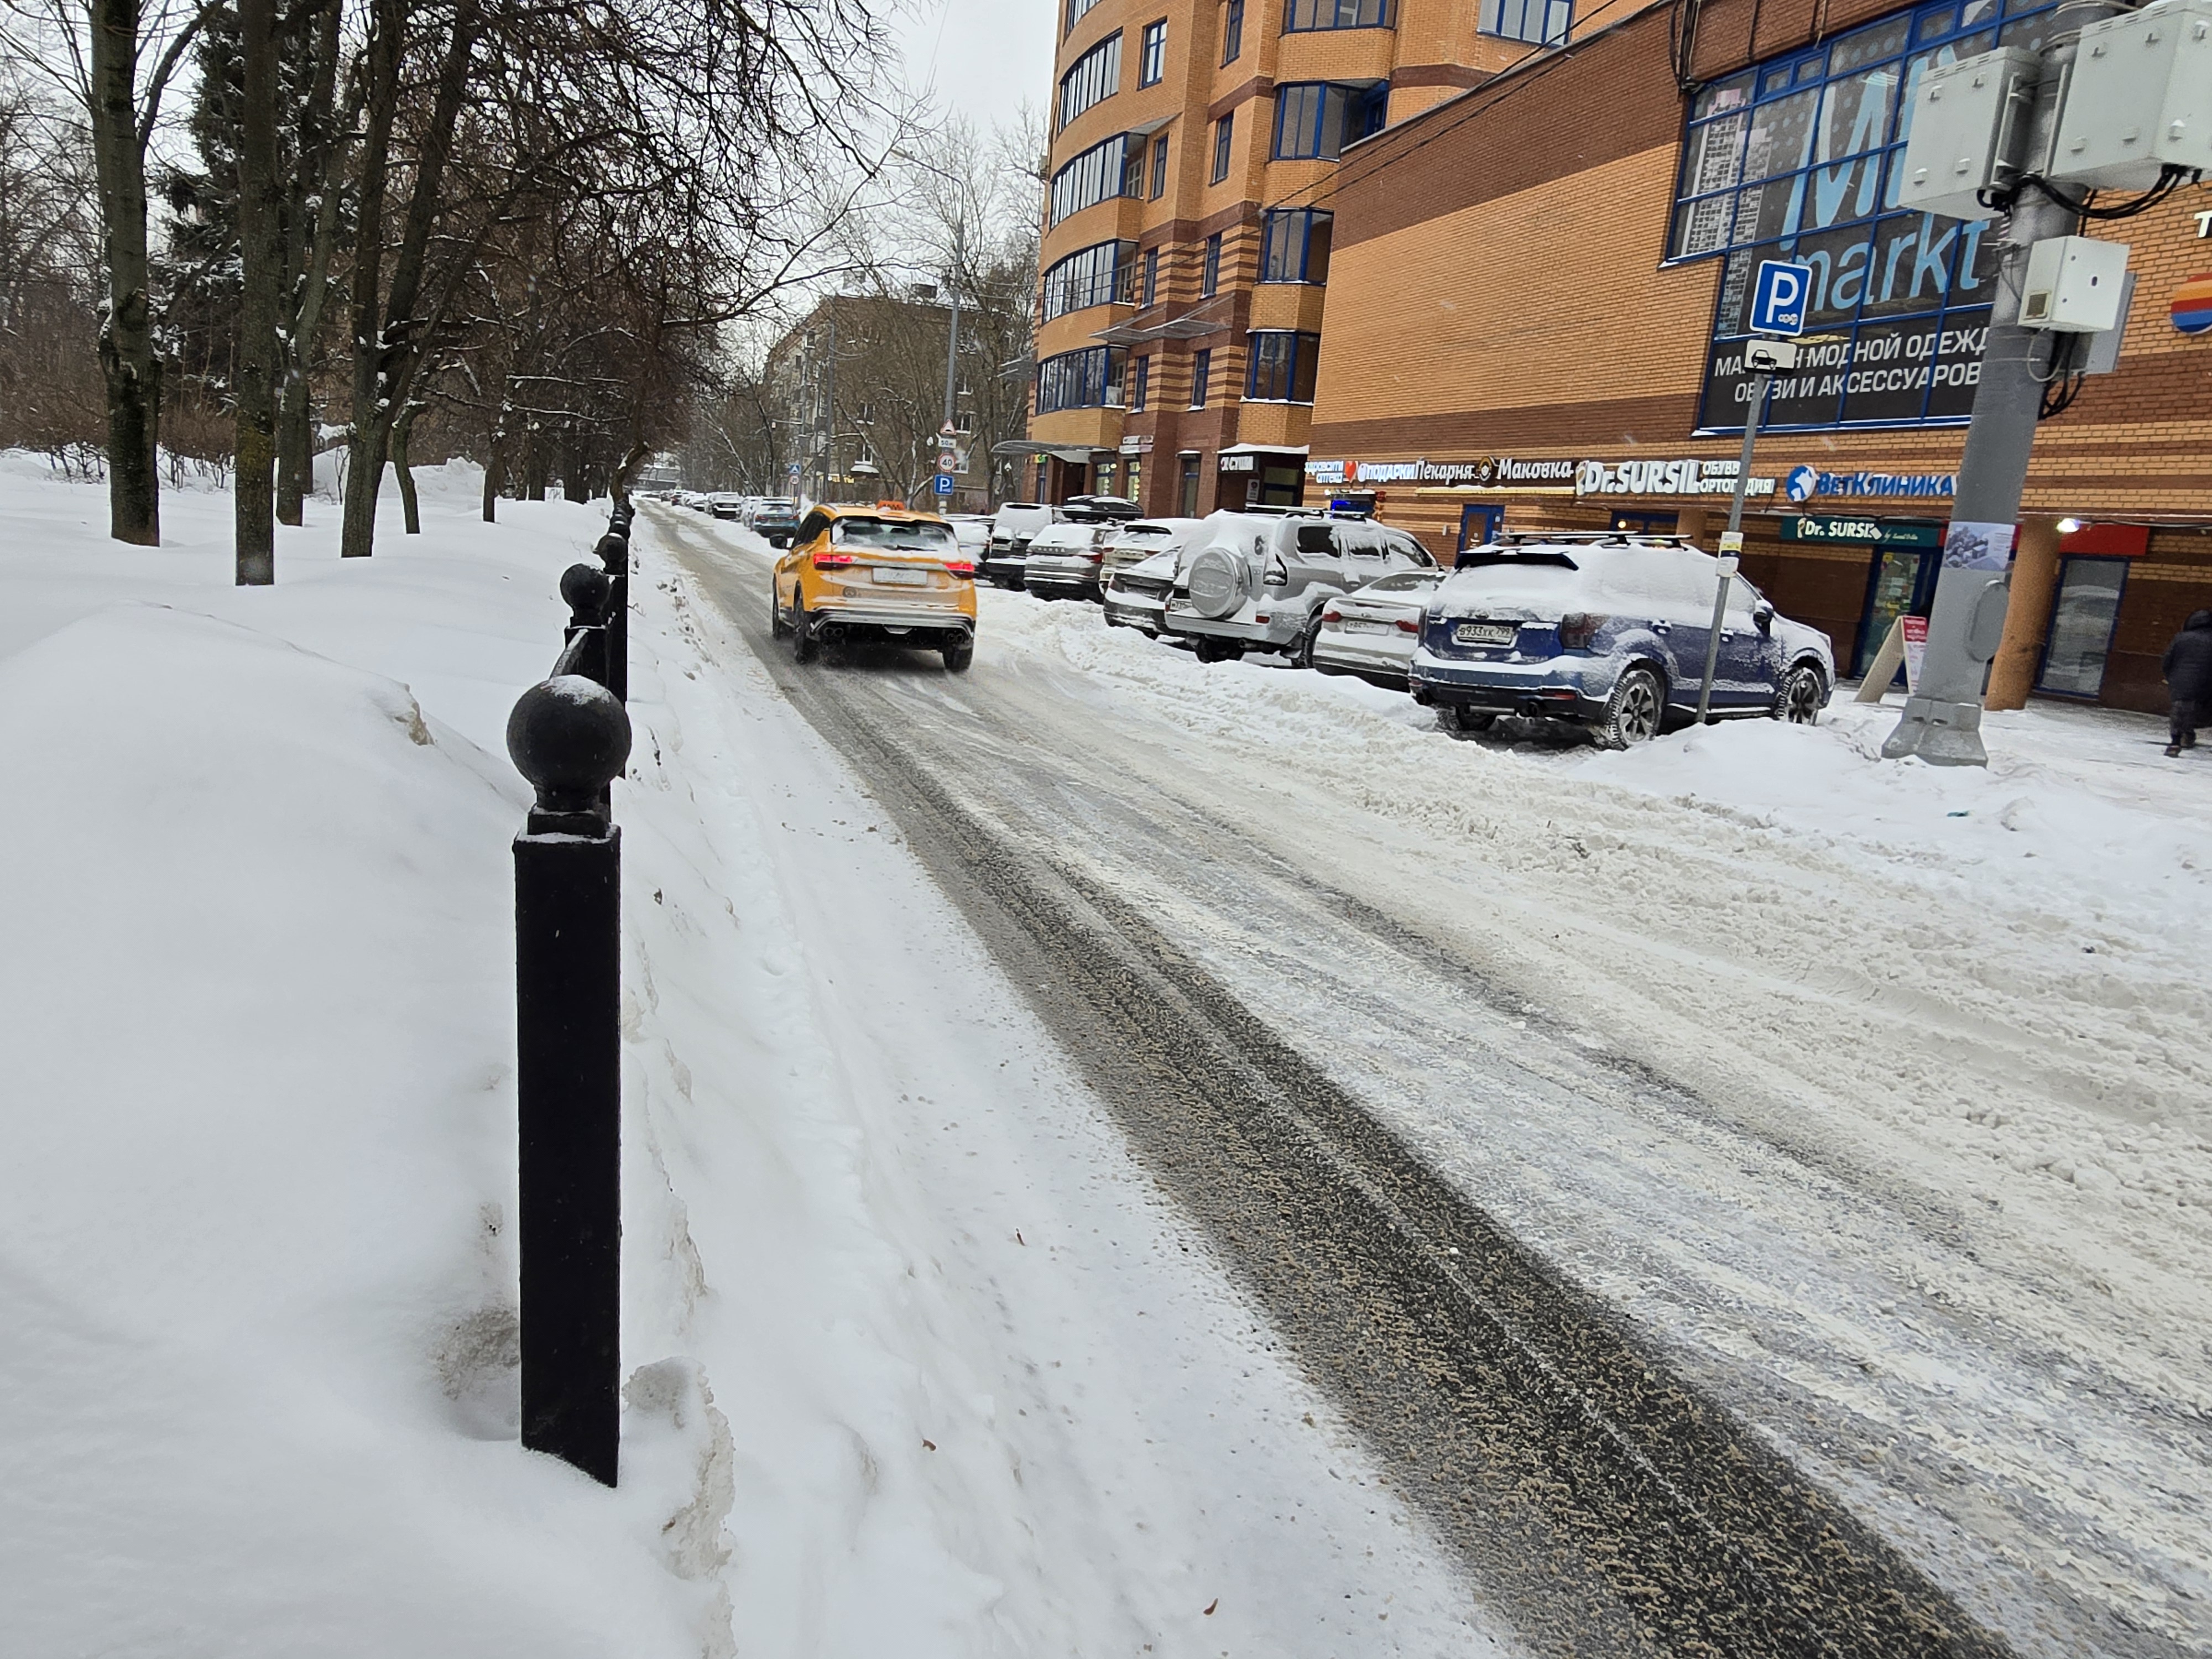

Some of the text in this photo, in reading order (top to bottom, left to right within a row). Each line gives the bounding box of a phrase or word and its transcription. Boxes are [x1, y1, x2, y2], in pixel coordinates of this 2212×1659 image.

[1766, 272, 1799, 323] P
[1806, 332, 1902, 369] МОДНОЙ
[1799, 376, 1816, 398] И
[1415, 458, 1574, 485] Пекарня Маковка
[1702, 461, 1741, 475] ОБУВЬ
[939, 477, 950, 493] P
[1699, 478, 1775, 496] ОРТОПДИЯ
[1804, 521, 1825, 536] Dr.
